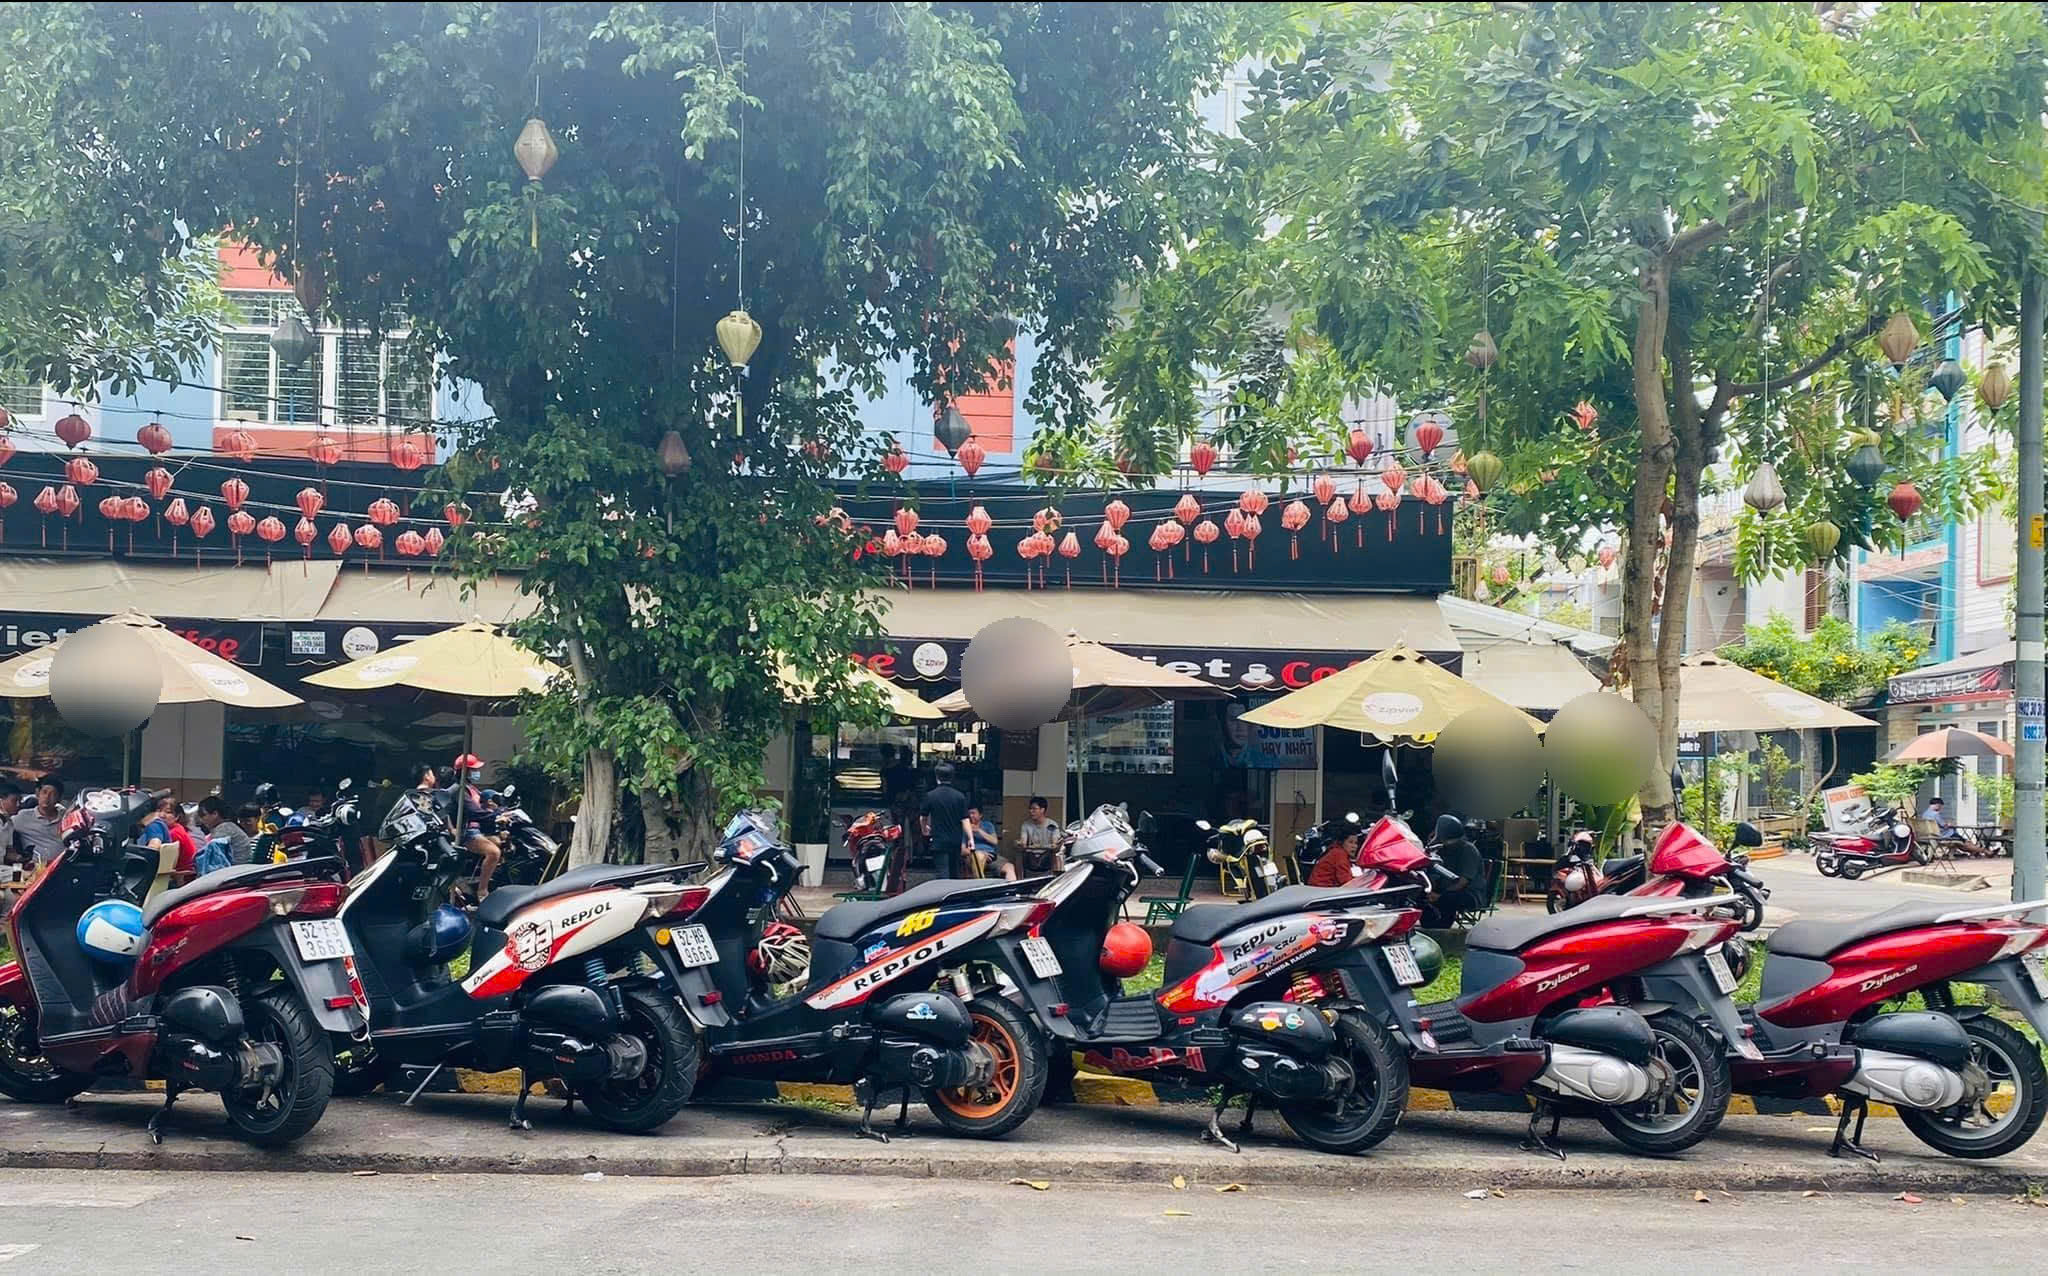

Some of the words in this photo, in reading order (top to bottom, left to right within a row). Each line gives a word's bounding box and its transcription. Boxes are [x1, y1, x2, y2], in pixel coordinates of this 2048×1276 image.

[561, 901, 612, 928] REPSOL
[896, 908, 941, 937] 46
[518, 920, 553, 962] 93
[685, 945, 713, 963] 9666
[1232, 921, 1287, 961] REPSOL
[854, 940, 948, 991] REPSOL
[1265, 961, 1290, 978] HONDA
[1290, 947, 1317, 966] RACING
[1536, 973, 1578, 993] Dylan
[1860, 973, 1905, 992] Dylan
[731, 1049, 797, 1064] HONDA
